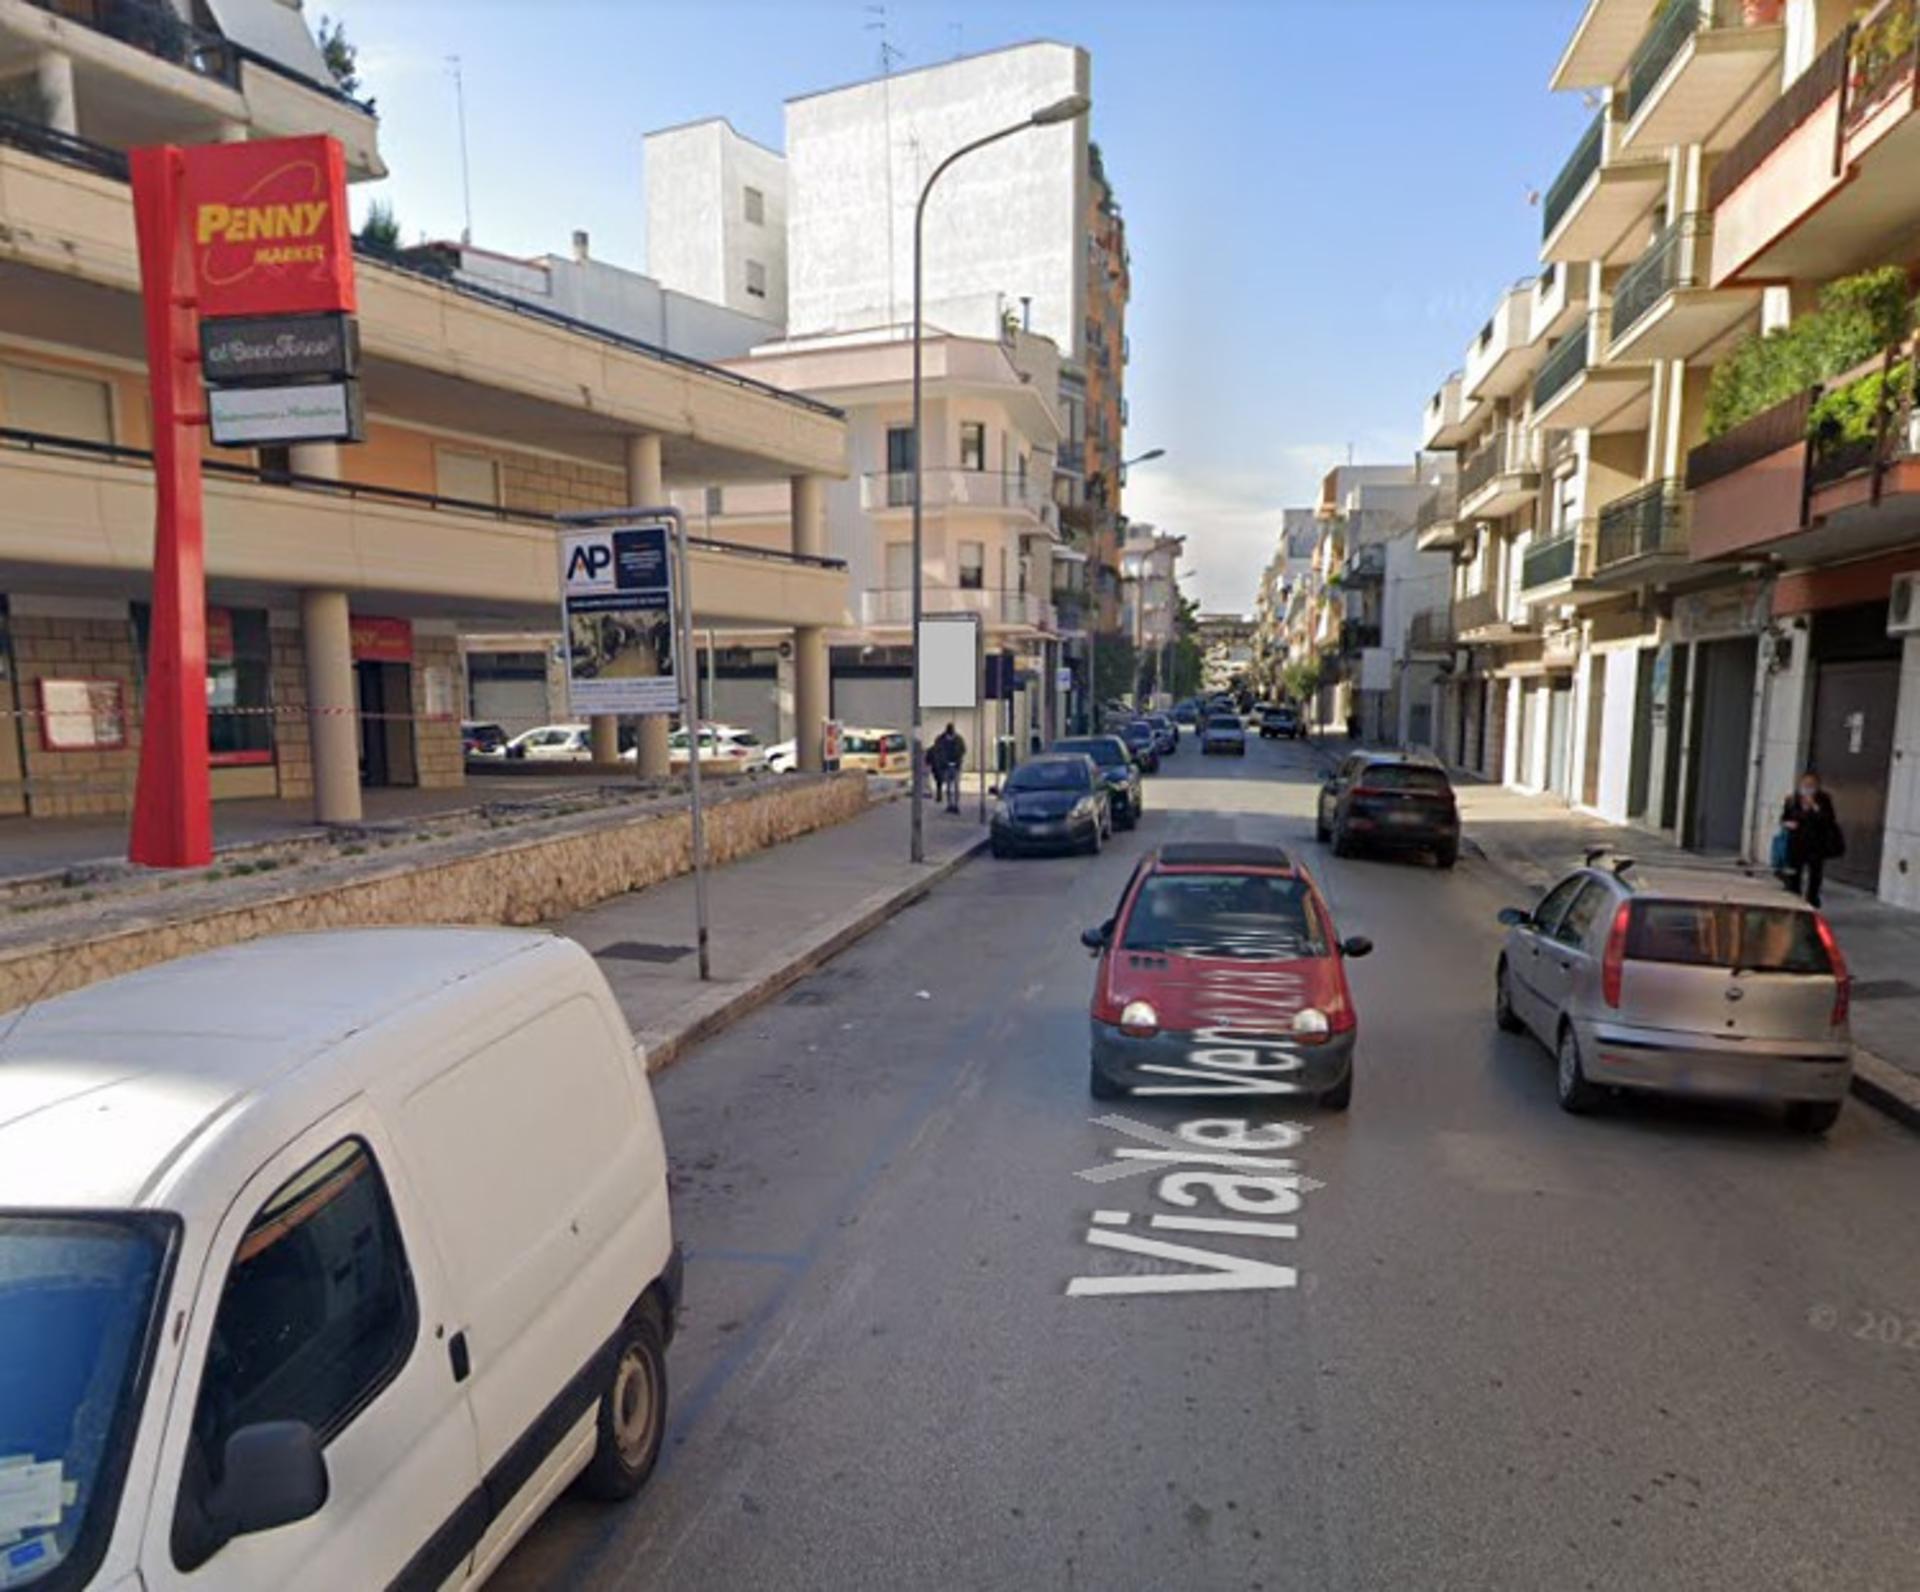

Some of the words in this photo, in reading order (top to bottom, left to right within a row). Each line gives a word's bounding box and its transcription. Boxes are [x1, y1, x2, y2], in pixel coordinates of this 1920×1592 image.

[197, 202, 328, 244] PENNY
[254, 245, 325, 266] MARKET
[567, 544, 611, 580] AP
